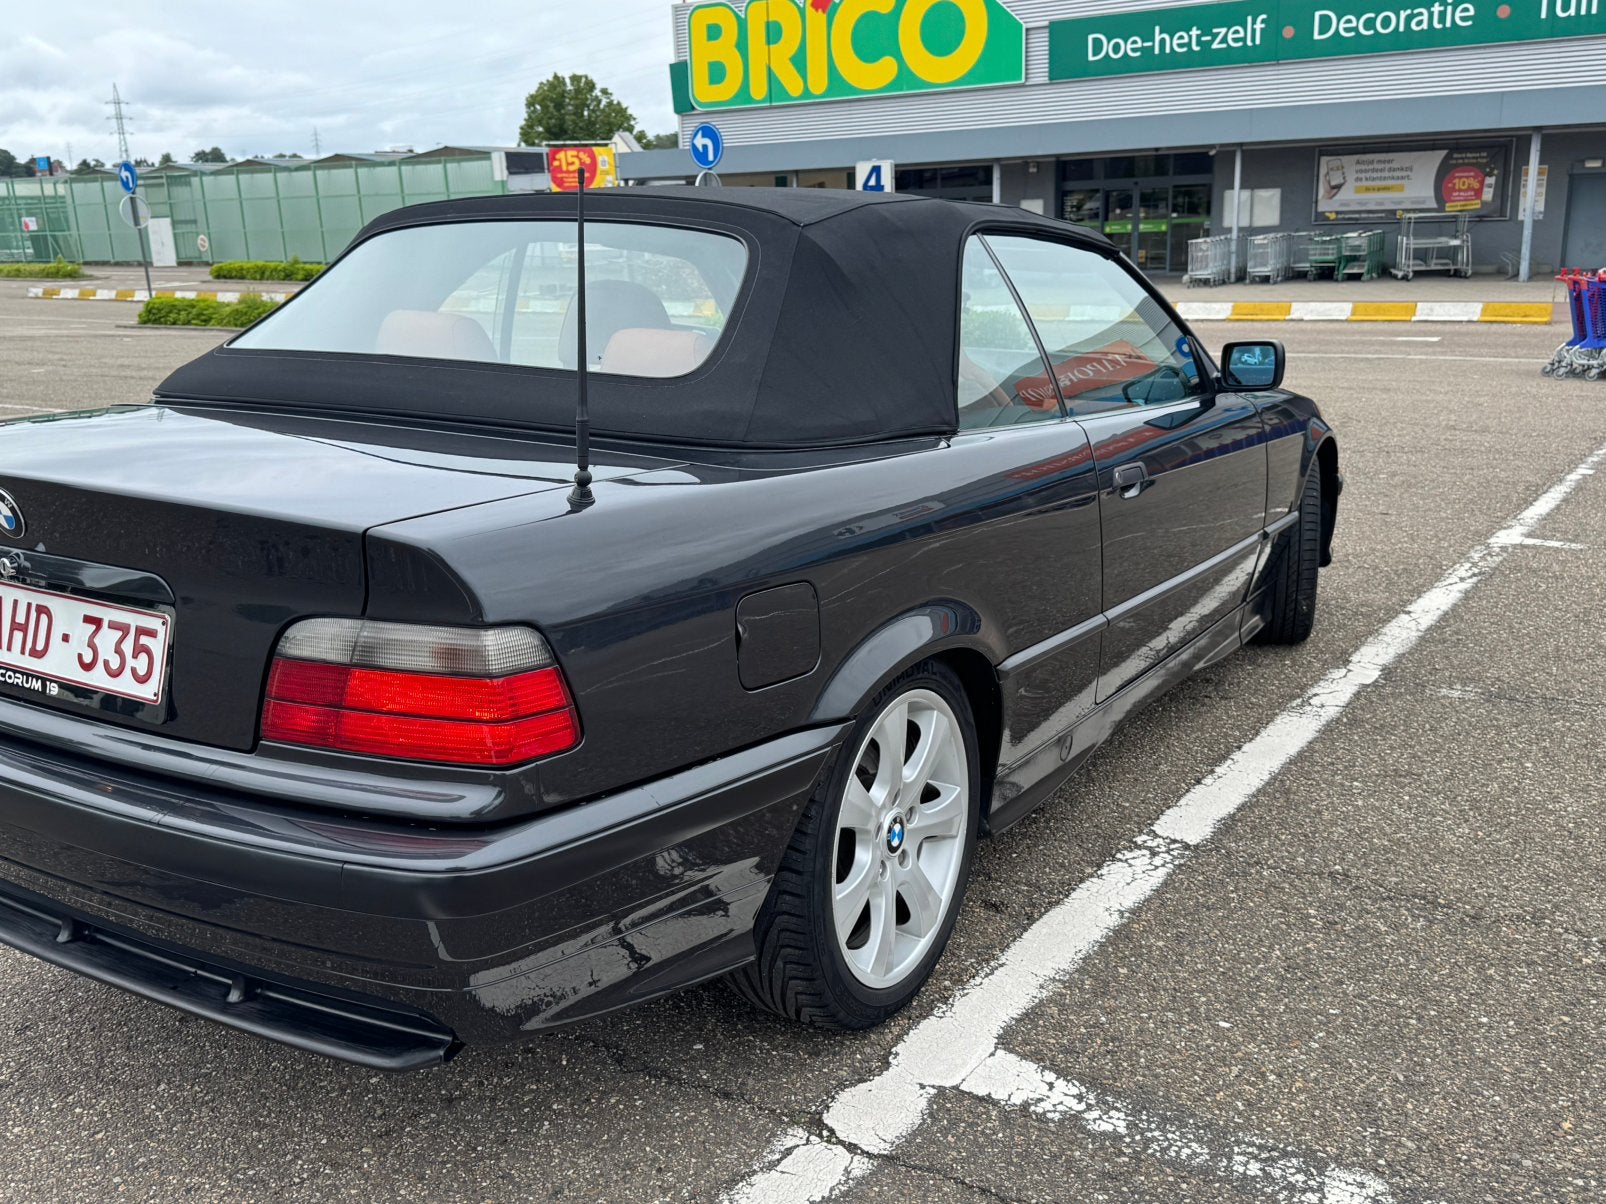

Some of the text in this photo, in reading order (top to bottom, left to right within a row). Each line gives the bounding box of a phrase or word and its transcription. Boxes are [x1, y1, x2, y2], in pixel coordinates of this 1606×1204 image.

[1087, 14, 1267, 61] Doe-het-zelf
[1313, 0, 1475, 40] Decoratie
[552, 150, 591, 172] -15%
[1355, 165, 1413, 174] voordeel dankzij
[863, 165, 884, 192] 4
[46, 680, 59, 696] 19
